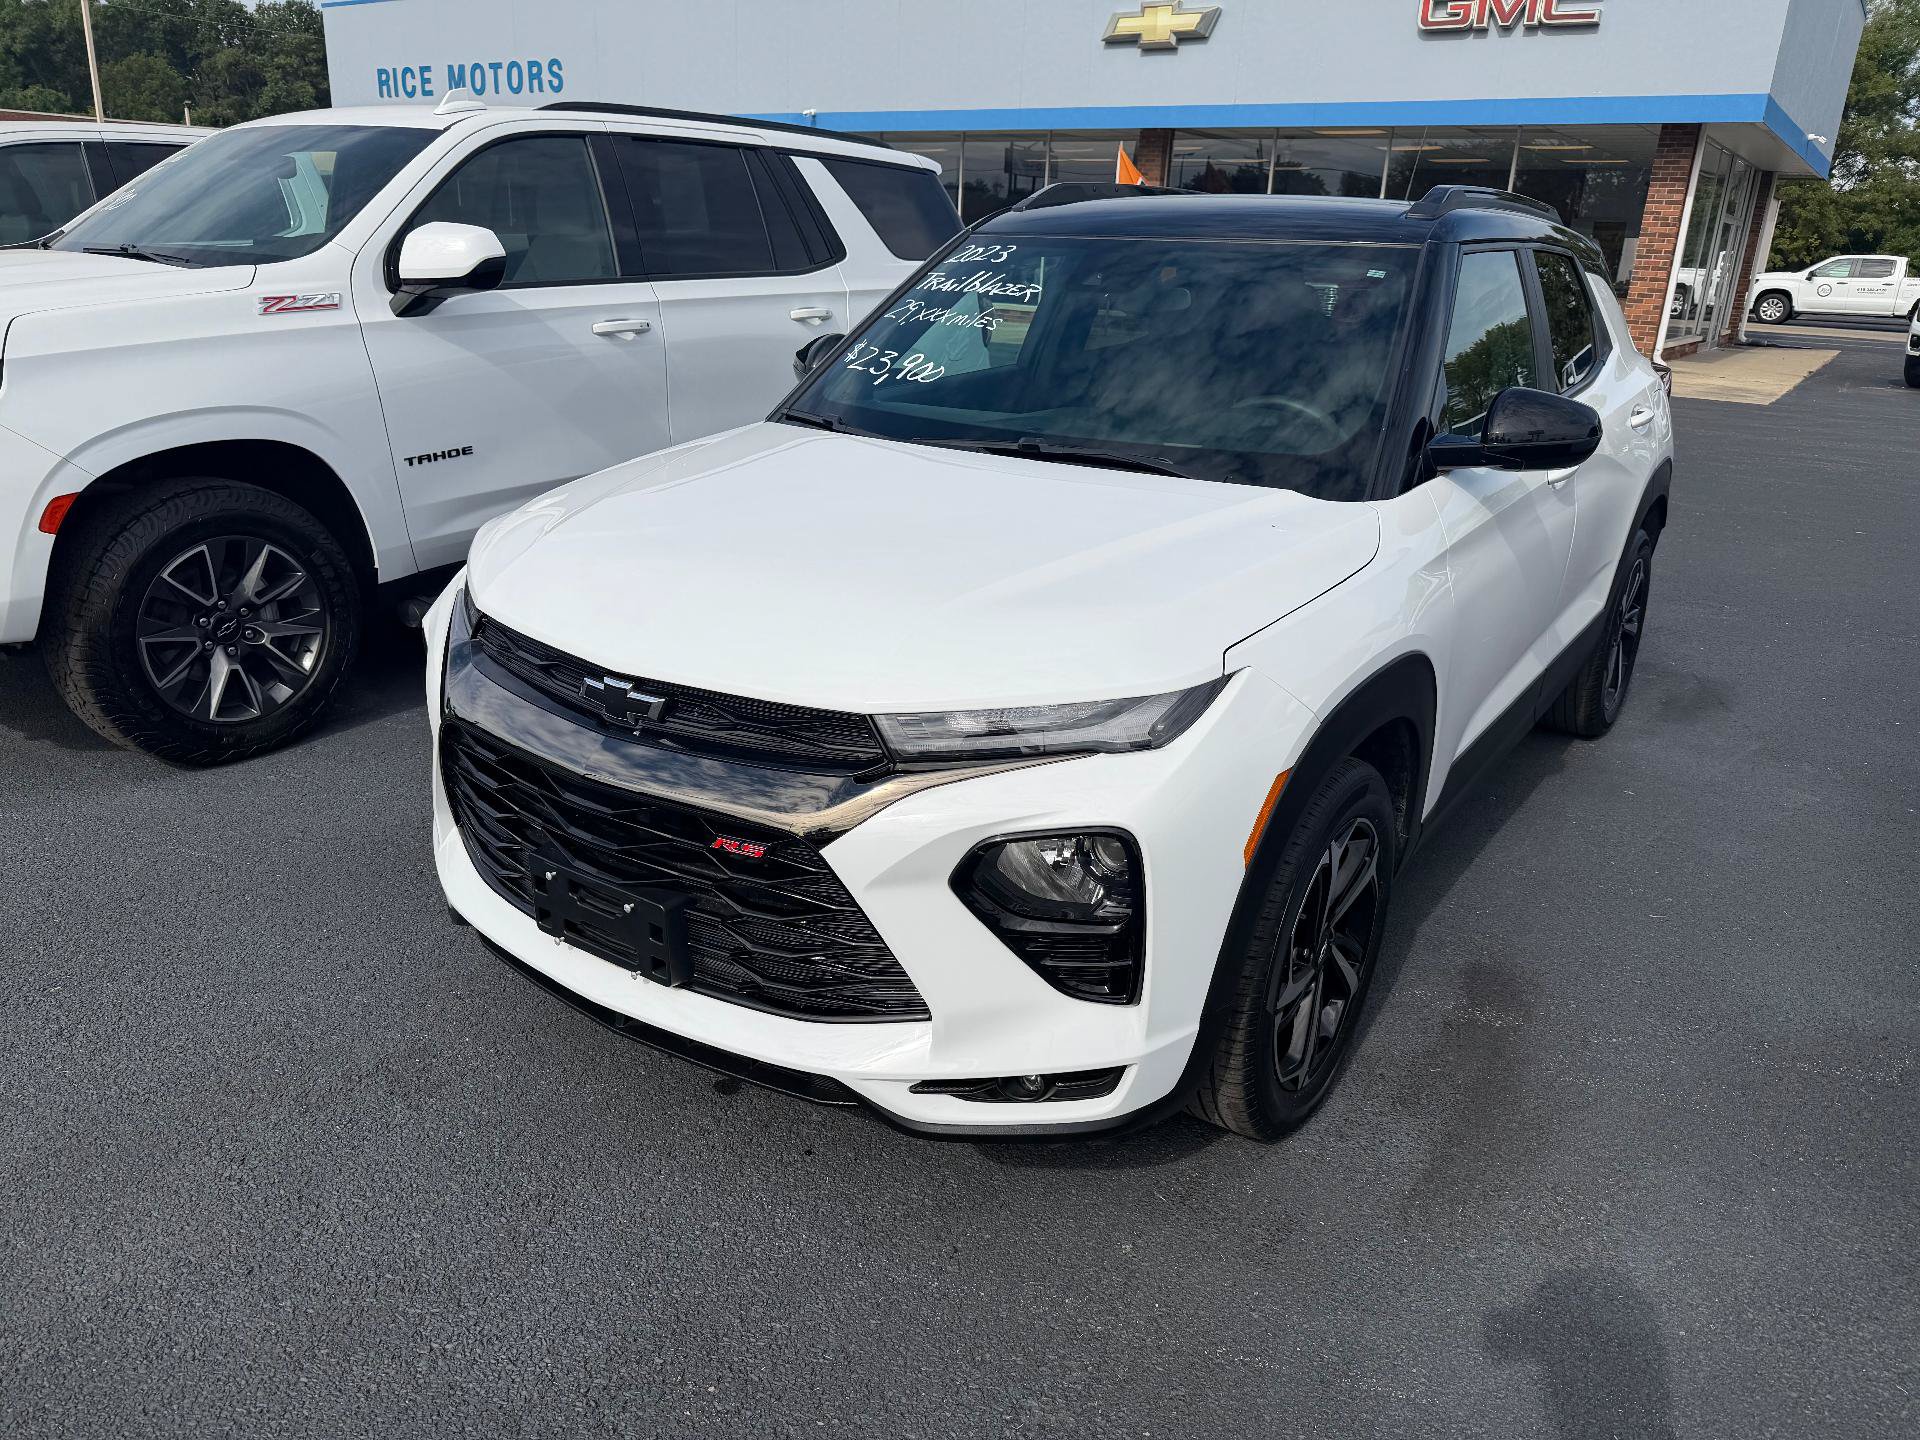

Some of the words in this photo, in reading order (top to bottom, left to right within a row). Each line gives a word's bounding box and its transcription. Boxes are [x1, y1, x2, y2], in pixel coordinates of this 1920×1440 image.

[1418, 0, 1601, 30] GMC
[377, 66, 434, 98] RICE
[447, 58, 565, 96] MOTORS
[944, 244, 1017, 263] 2023
[259, 292, 341, 315] Z71
[844, 339, 945, 385] $23,900
[403, 445, 474, 467] TAHOE
[710, 836, 767, 858] RS
